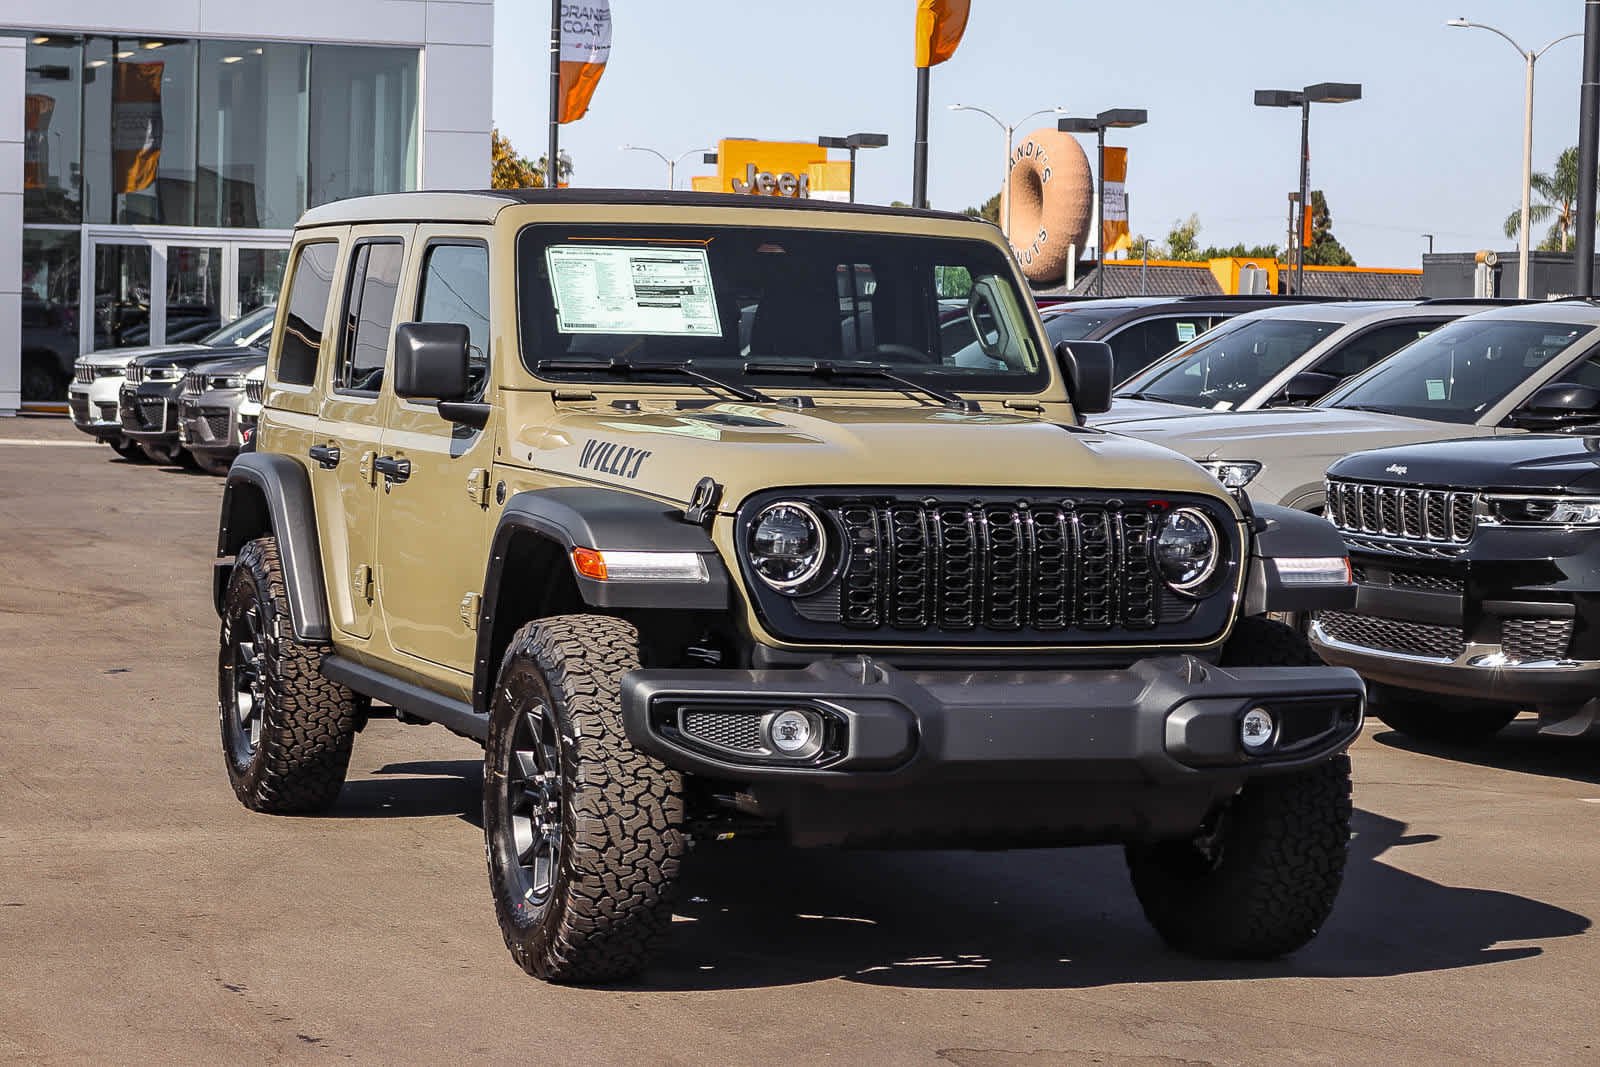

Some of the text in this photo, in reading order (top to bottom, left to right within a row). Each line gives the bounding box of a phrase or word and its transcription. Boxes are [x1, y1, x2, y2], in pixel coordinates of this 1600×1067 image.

[561, 4, 610, 21] ORANE
[563, 20, 604, 37] COAT
[1009, 142, 1052, 184] ANDY'S
[1010, 229, 1047, 265] NUTS
[579, 439, 652, 479] WILLYS
